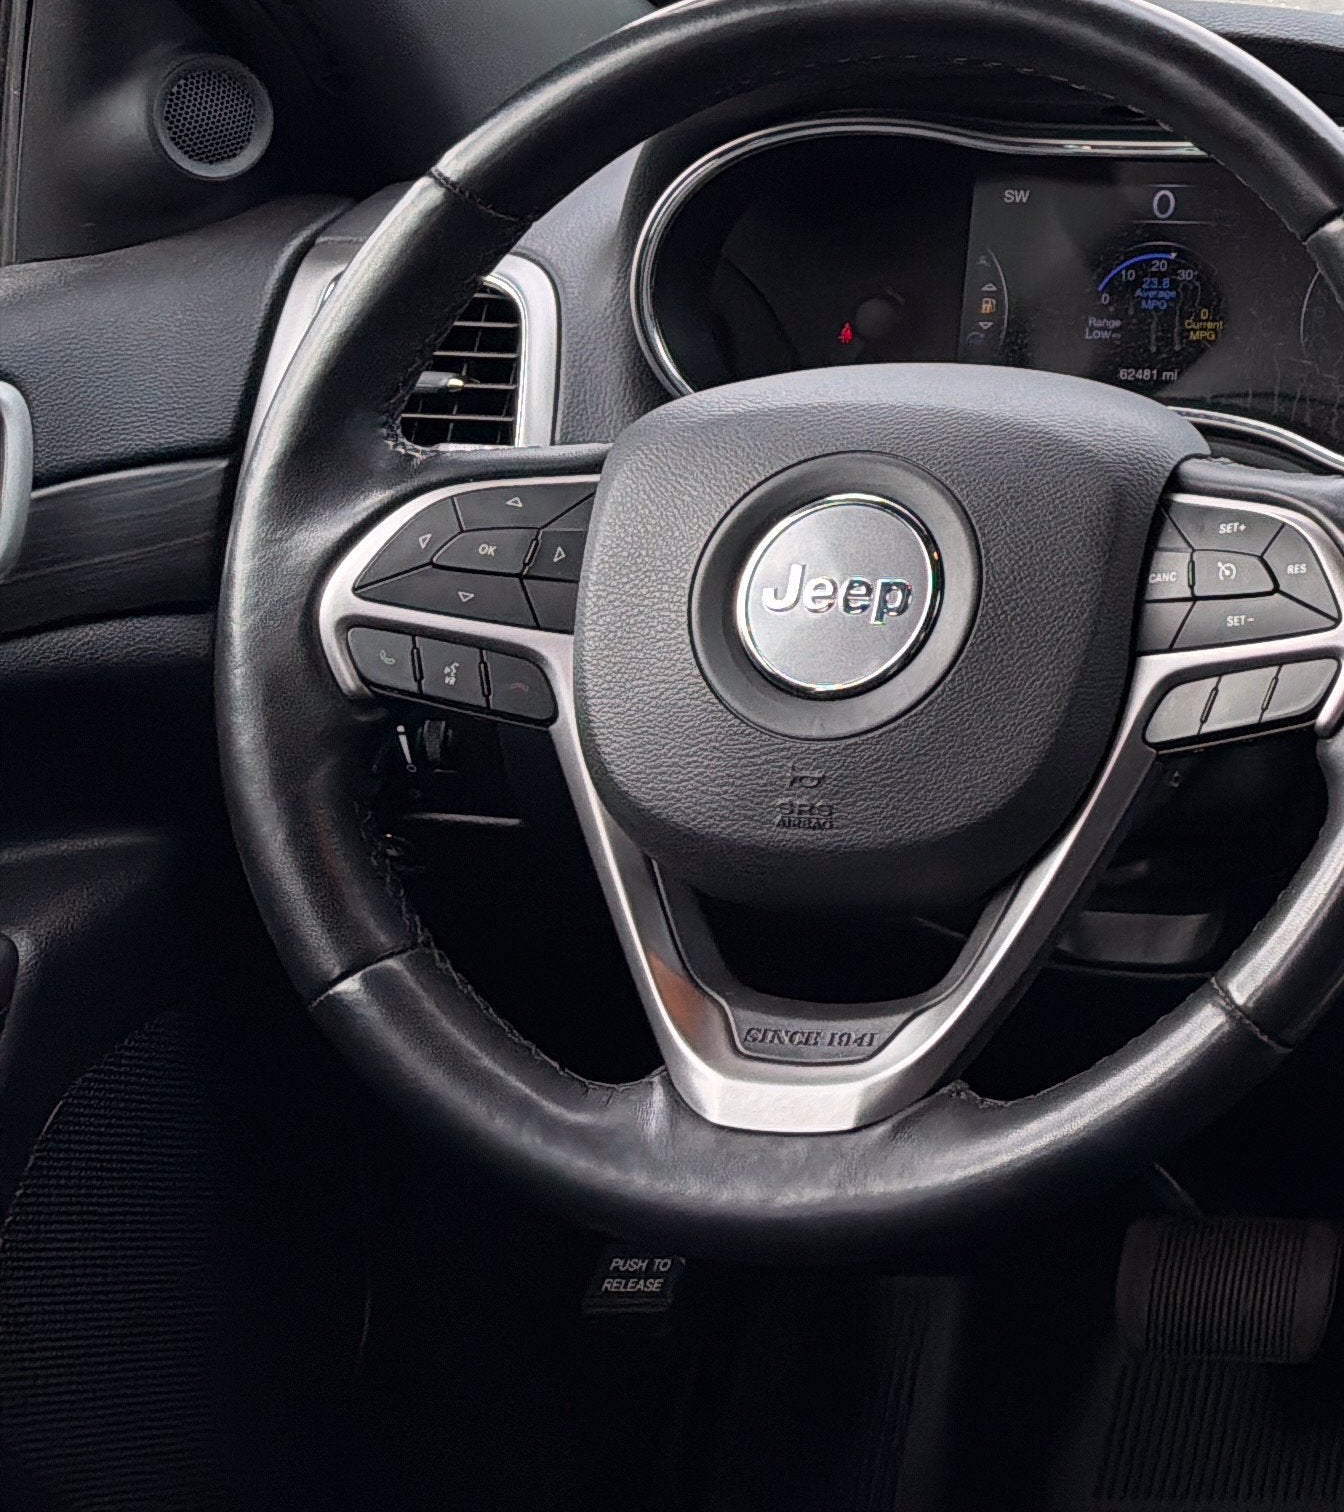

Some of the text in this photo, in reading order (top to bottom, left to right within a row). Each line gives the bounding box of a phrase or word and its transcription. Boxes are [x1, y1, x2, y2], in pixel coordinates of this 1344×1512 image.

[1003, 190, 1030, 204] SW
[1152, 189, 1176, 219] 0
[1151, 260, 1168, 271] 20
[1121, 269, 1136, 281] 10
[1177, 269, 1194, 281] 30
[1142, 277, 1170, 289] 23.8
[1101, 294, 1110, 305] 0
[1135, 288, 1177, 301] Average
[1141, 300, 1168, 310] MPG
[1088, 317, 1122, 330] Range
[1184, 319, 1224, 330] Current
[1189, 330, 1216, 341] MPG
[1119, 368, 1158, 381] 62481
[478, 543, 497, 556] OK
[1286, 563, 1307, 575] RES
[1148, 571, 1177, 584] CANC
[761, 563, 912, 626] Jeep
[776, 817, 834, 832] AIRBAG
[743, 1027, 822, 1047] SINCE
[609, 1258, 672, 1272] PUSH TO
[601, 1278, 664, 1292] RELEASE
